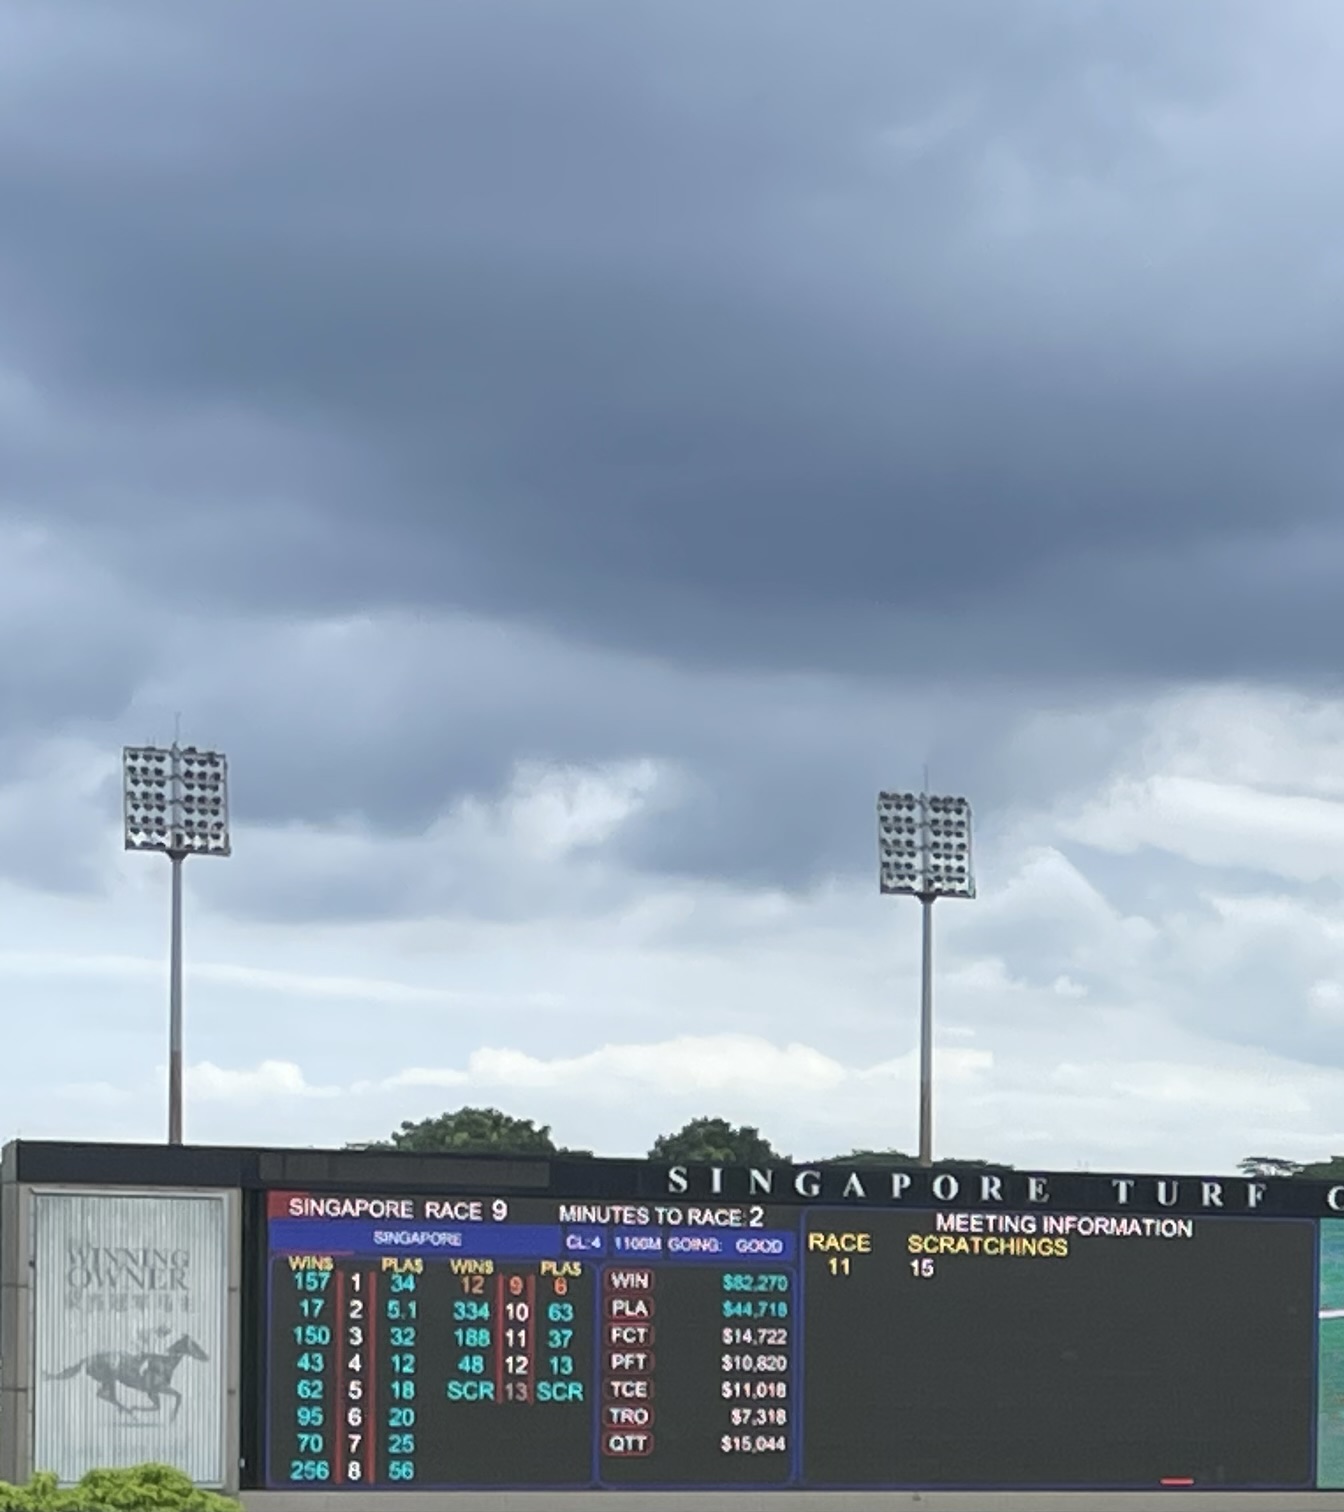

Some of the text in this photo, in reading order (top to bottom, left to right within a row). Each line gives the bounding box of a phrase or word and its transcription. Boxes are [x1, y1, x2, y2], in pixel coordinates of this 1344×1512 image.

[668, 1165, 1050, 1202] SINGAPORE
[1112, 1179, 1268, 1209] TURF
[288, 1198, 508, 1222] SINGAPORE RACE 9
[558, 1204, 650, 1225] MINUTES
[655, 1207, 683, 1225] TO
[749, 1206, 764, 1228] 2
[936, 1212, 1193, 1238] MEETING INFORMATION
[373, 1230, 462, 1247] SINGAPORE
[615, 1236, 662, 1250] 1100M
[667, 1237, 784, 1254] GOING: GOOD
[808, 1232, 1068, 1257] RACE SCRATCHINGS
[68, 1242, 190, 1268] WINNING
[828, 1258, 935, 1278] 11 15
[68, 1266, 190, 1291] OWNER
[294, 1272, 416, 1293] 157 1 34
[461, 1276, 568, 1295] 12 9 6
[610, 1272, 648, 1289] WIN
[301, 1299, 416, 1319] 17 2 5.1
[453, 1301, 574, 1321] 334 10 63
[611, 1299, 648, 1317] PLA
[293, 1326, 416, 1347] 150 3 32
[506, 1329, 526, 1347] 11
[548, 1329, 573, 1348] 37
[611, 1327, 787, 1346] FCT $14,722
[297, 1353, 415, 1373] 43 4 12
[458, 1355, 573, 1374] 48 12 13
[611, 1353, 787, 1373] PFT $10,820
[297, 1380, 415, 1400] 62 5 18
[447, 1381, 584, 1402] SCR 13 SCR
[610, 1381, 647, 1398] TCE
[297, 1406, 414, 1427] 95 6 20
[609, 1408, 648, 1425] TRO
[297, 1433, 414, 1454] 70 7 25
[609, 1435, 647, 1452] QTT
[290, 1460, 330, 1480] 256
[348, 1461, 362, 1480] 8
